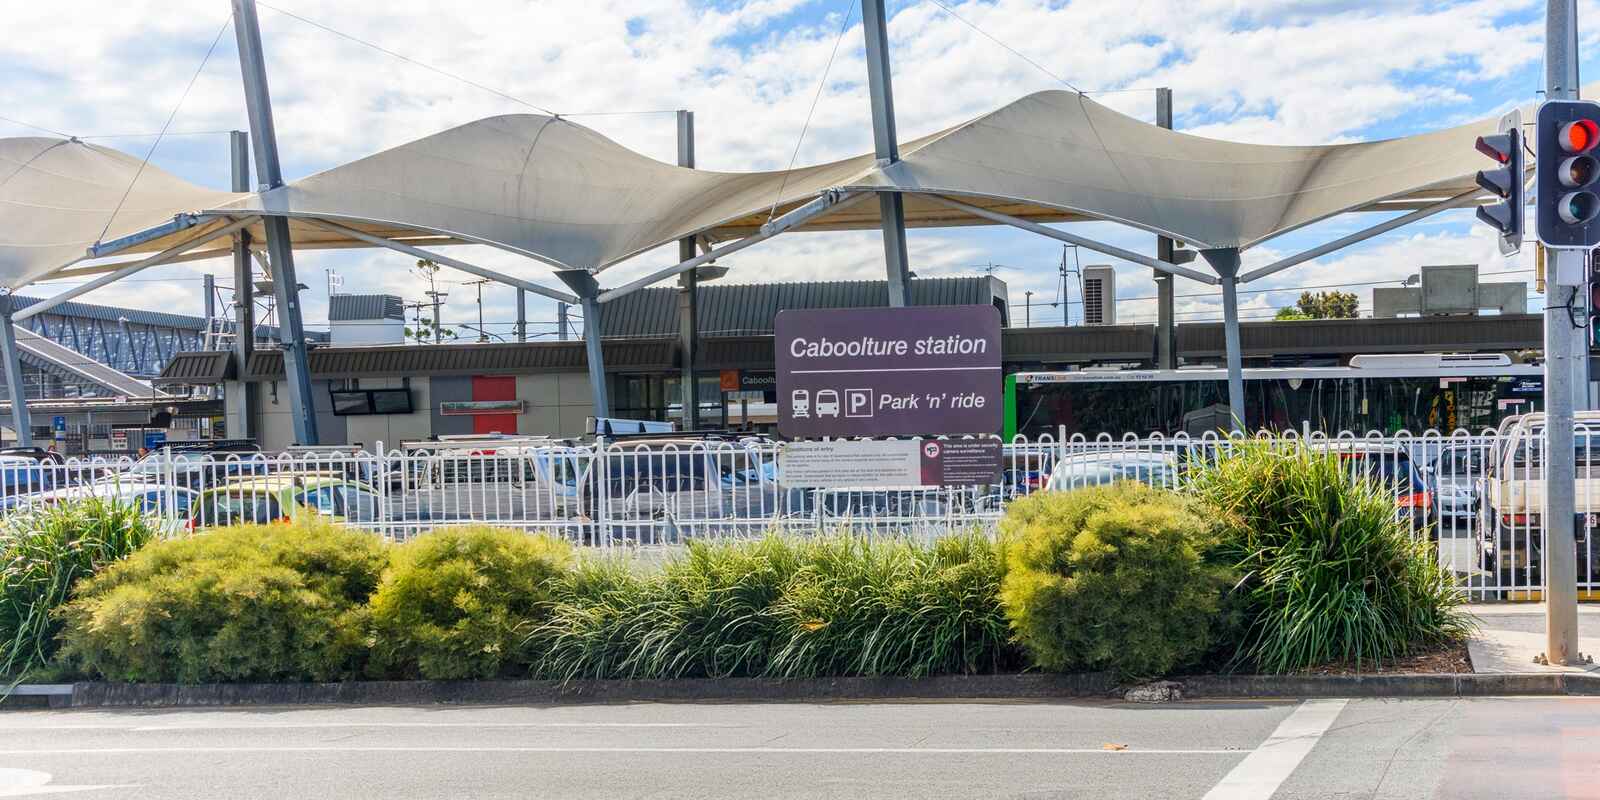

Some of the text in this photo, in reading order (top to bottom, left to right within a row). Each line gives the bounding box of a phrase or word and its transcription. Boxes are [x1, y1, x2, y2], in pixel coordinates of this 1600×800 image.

[790, 335, 987, 358] Caboolture station
[851, 393, 867, 414] P
[878, 393, 920, 410] Park
[950, 393, 986, 409] ride
